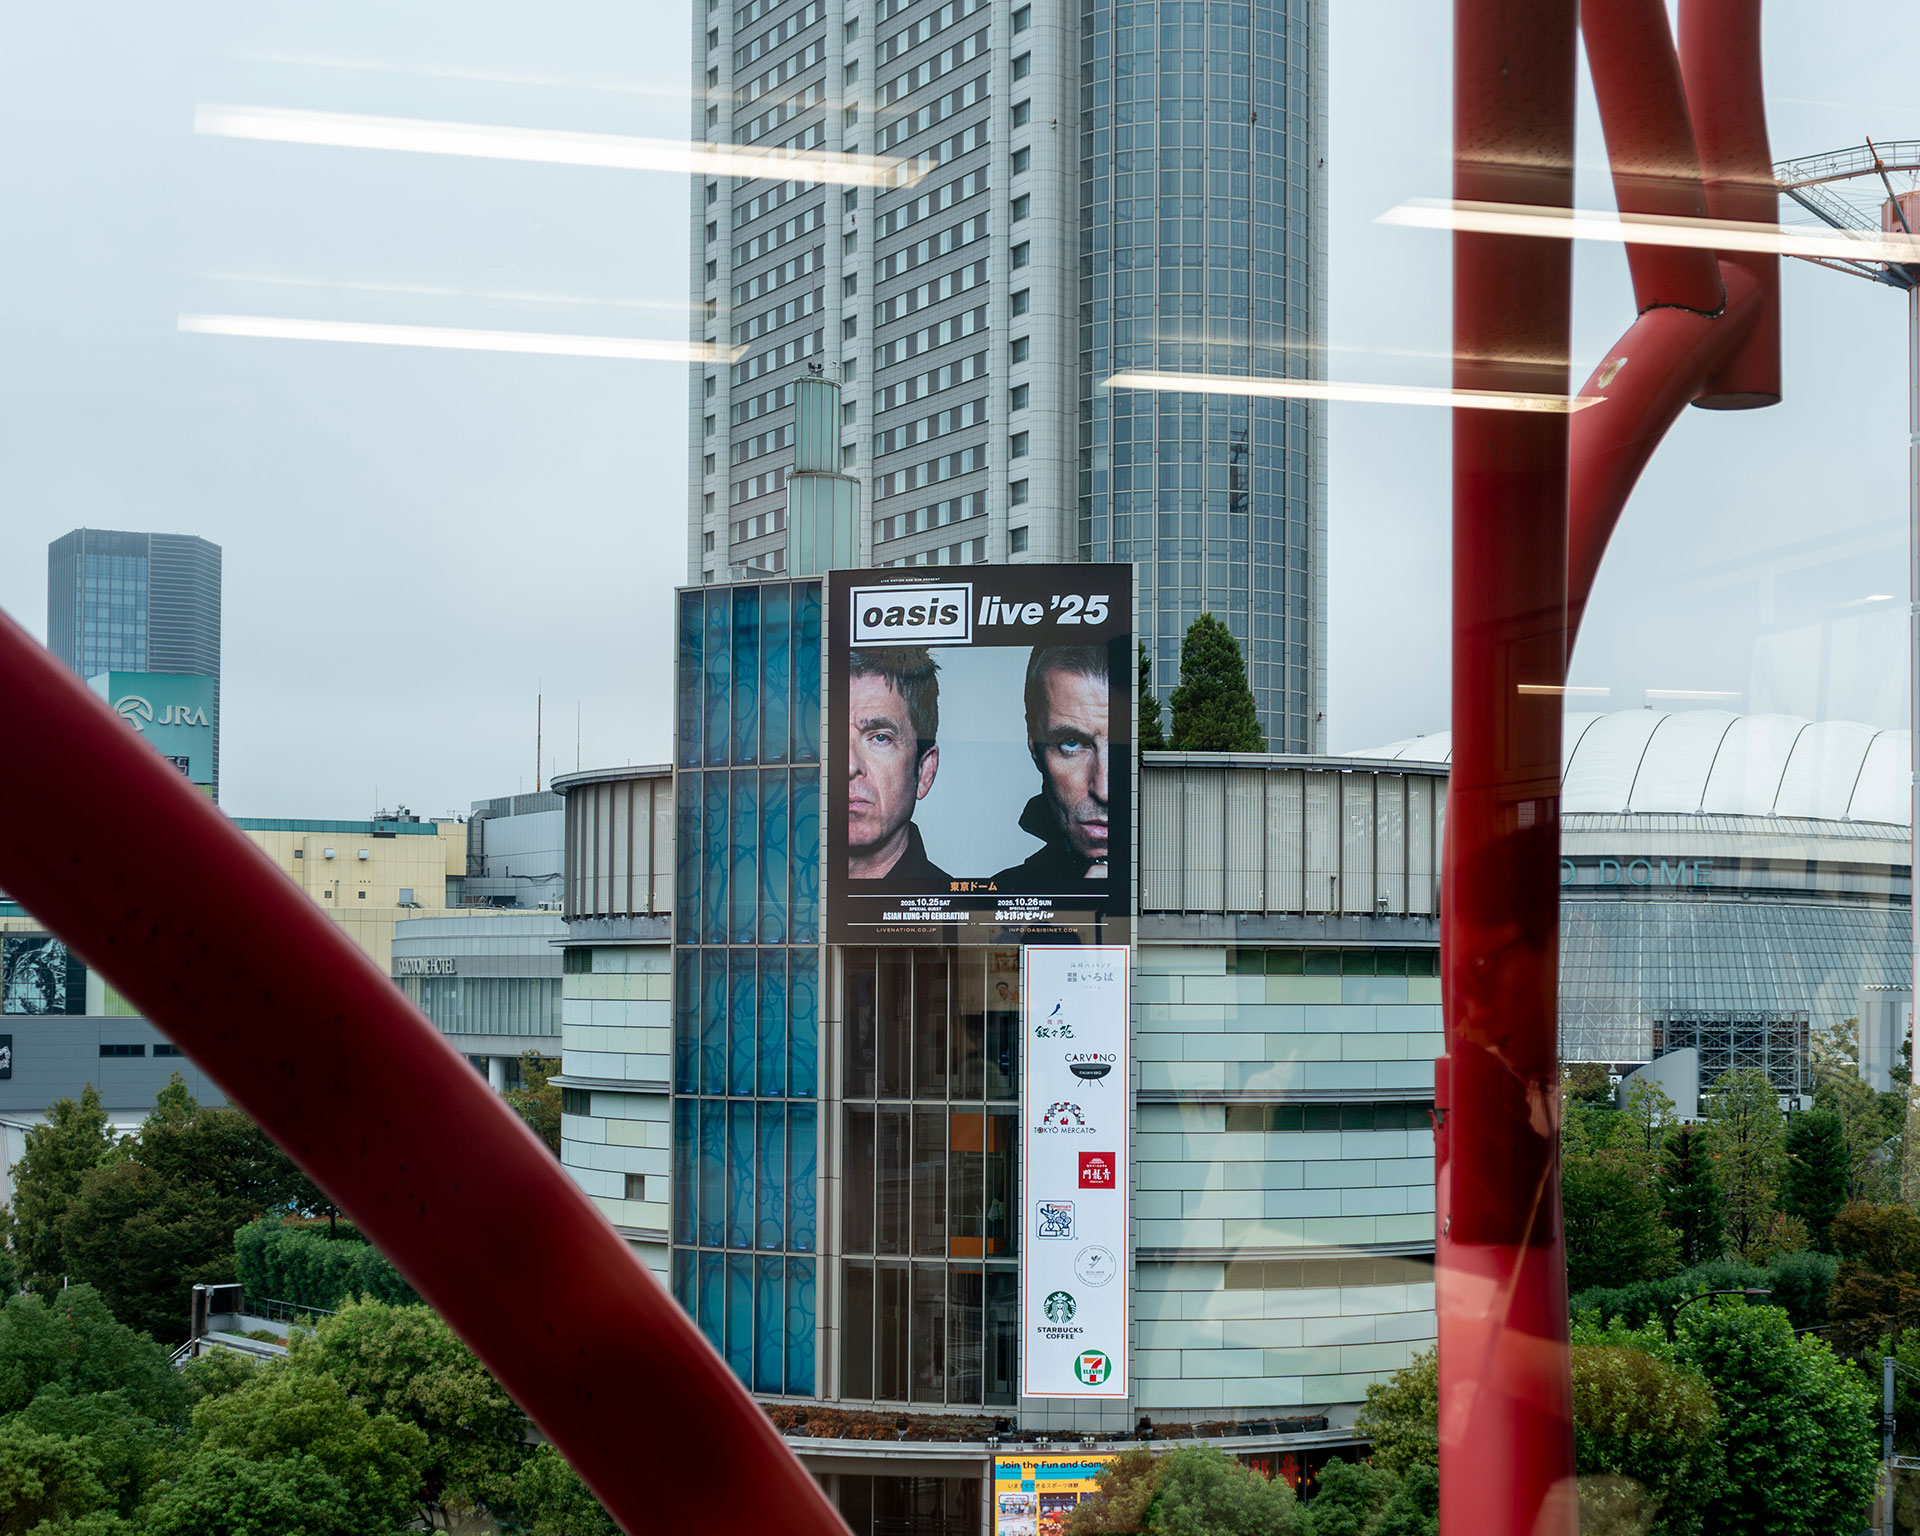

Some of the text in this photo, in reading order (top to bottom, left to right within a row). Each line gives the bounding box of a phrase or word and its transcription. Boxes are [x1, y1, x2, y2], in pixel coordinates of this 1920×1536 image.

[863, 595, 1109, 627] oasis live '25
[158, 705, 209, 727] JRA
[1600, 859, 1714, 886] DOME
[950, 881, 998, 892] 東京ドーム
[883, 912, 970, 920] ASIAN KUNG-FU GENERATION
[431, 958, 455, 974] HOTEL
[1081, 972, 1114, 982] いろは
[1000, 1461, 1020, 1469] Join
[1023, 1461, 1039, 1469] the
[1041, 1461, 1059, 1469] Fun
[1060, 1460, 1078, 1469] and
